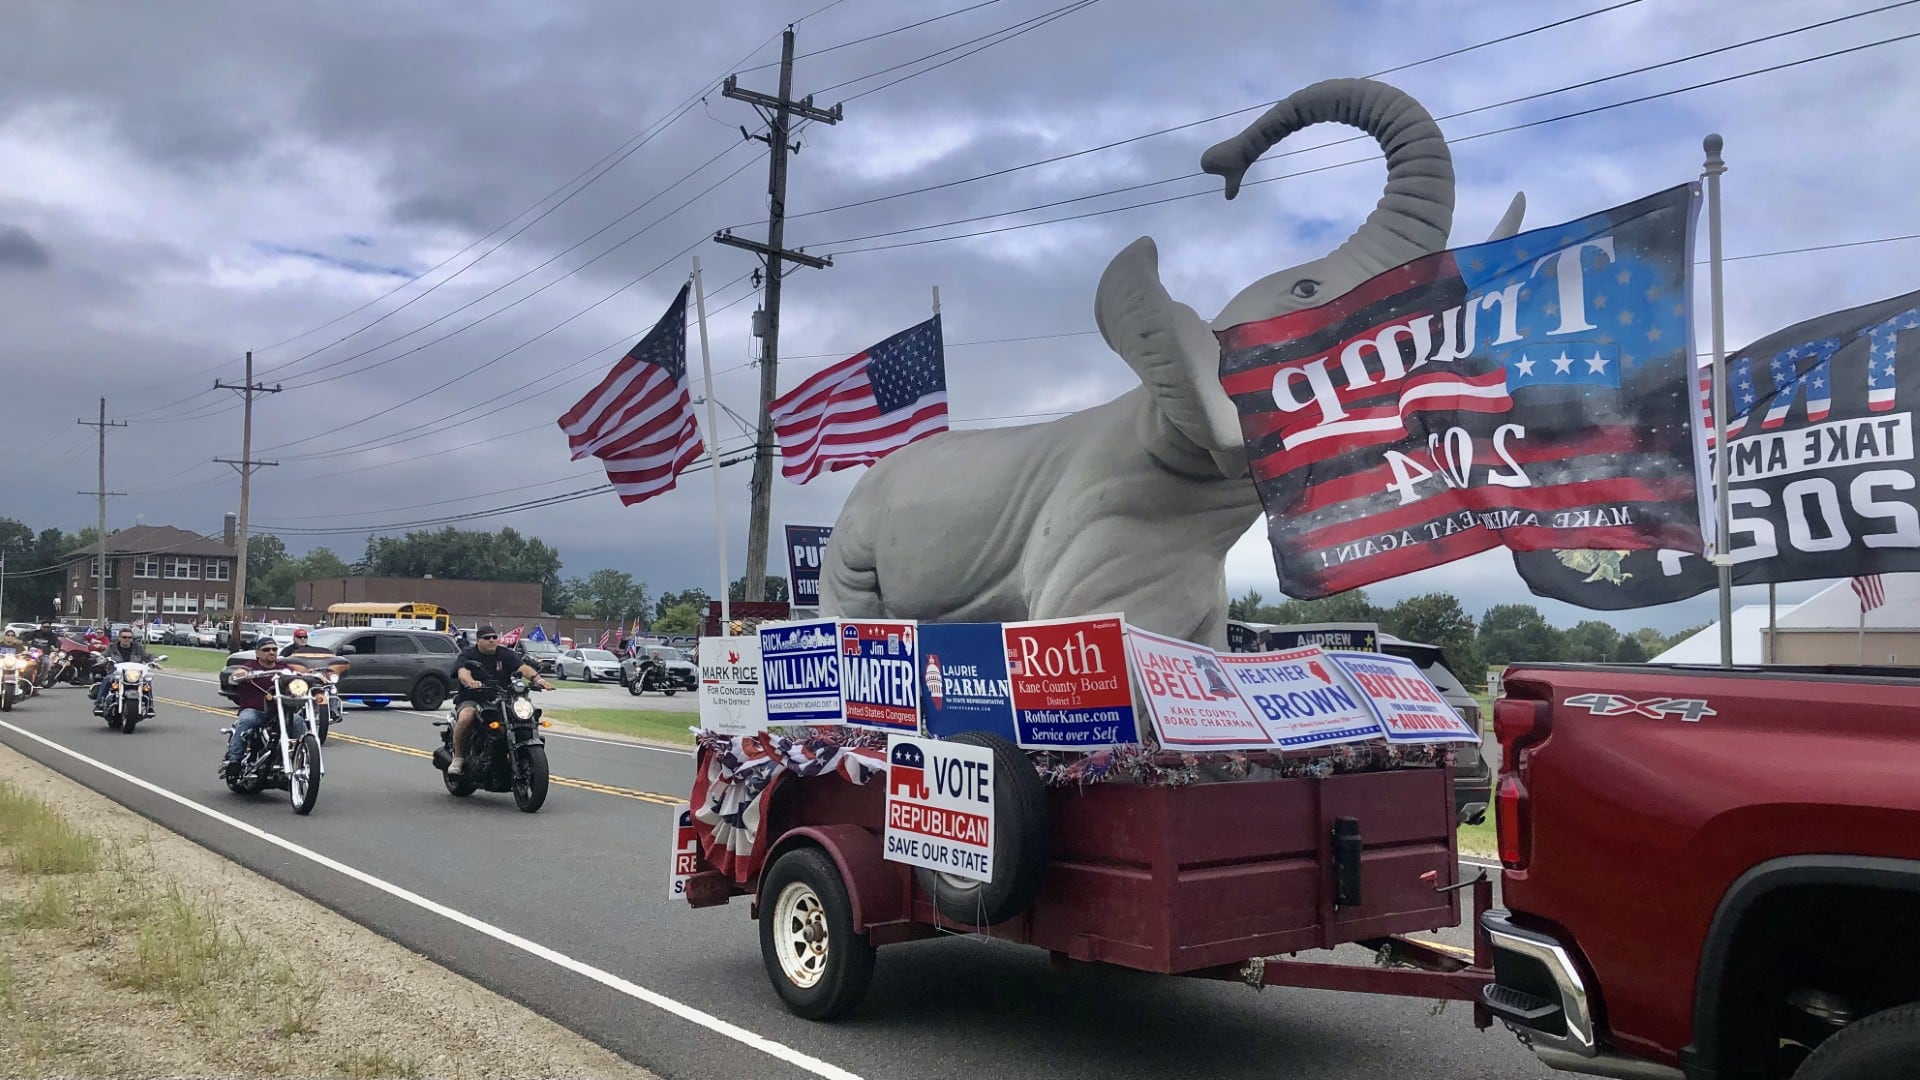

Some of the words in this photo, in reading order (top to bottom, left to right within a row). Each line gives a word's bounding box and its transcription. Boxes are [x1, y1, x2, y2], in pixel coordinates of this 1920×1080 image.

[797, 579, 820, 595] STATE
[762, 633, 782, 652] RICK
[870, 641, 884, 656] Jim
[1018, 630, 1106, 677] Roth
[1137, 648, 1197, 676] LANCE
[702, 666, 730, 680] MARK
[732, 667, 758, 680] RICE
[764, 655, 839, 691] WILLIAMS
[942, 665, 978, 677] LAURIE
[1234, 664, 1310, 685] HEATHER
[844, 657, 915, 708] MARTER
[944, 678, 1009, 697] PARMAN
[1018, 680, 1041, 693] Kane
[1042, 679, 1077, 695] County
[1081, 675, 1118, 691] Board
[1144, 668, 1217, 701] BELL
[1354, 672, 1442, 704] BUTLER
[1046, 696, 1069, 706] District
[1072, 695, 1081, 705] 12
[1252, 684, 1358, 722] BROWN
[865, 707, 885, 719] States
[885, 711, 916, 723] Congress
[1024, 710, 1120, 724] RothforKane.com
[1163, 715, 1198, 727] BOARD
[1201, 718, 1254, 729] CHAIRMAN
[1169, 706, 1196, 716] KANE
[1199, 708, 1237, 719] COUNTY
[1396, 713, 1455, 730] AUDITOR
[1032, 727, 1064, 741] Service
[1065, 730, 1090, 741] over
[1092, 726, 1119, 743] Self
[933, 755, 990, 803] VOTE
[890, 803, 988, 844] REPUBLICAN
[888, 835, 918, 858] SAVE
[922, 842, 948, 864] OUR
[951, 848, 988, 874] STATE
